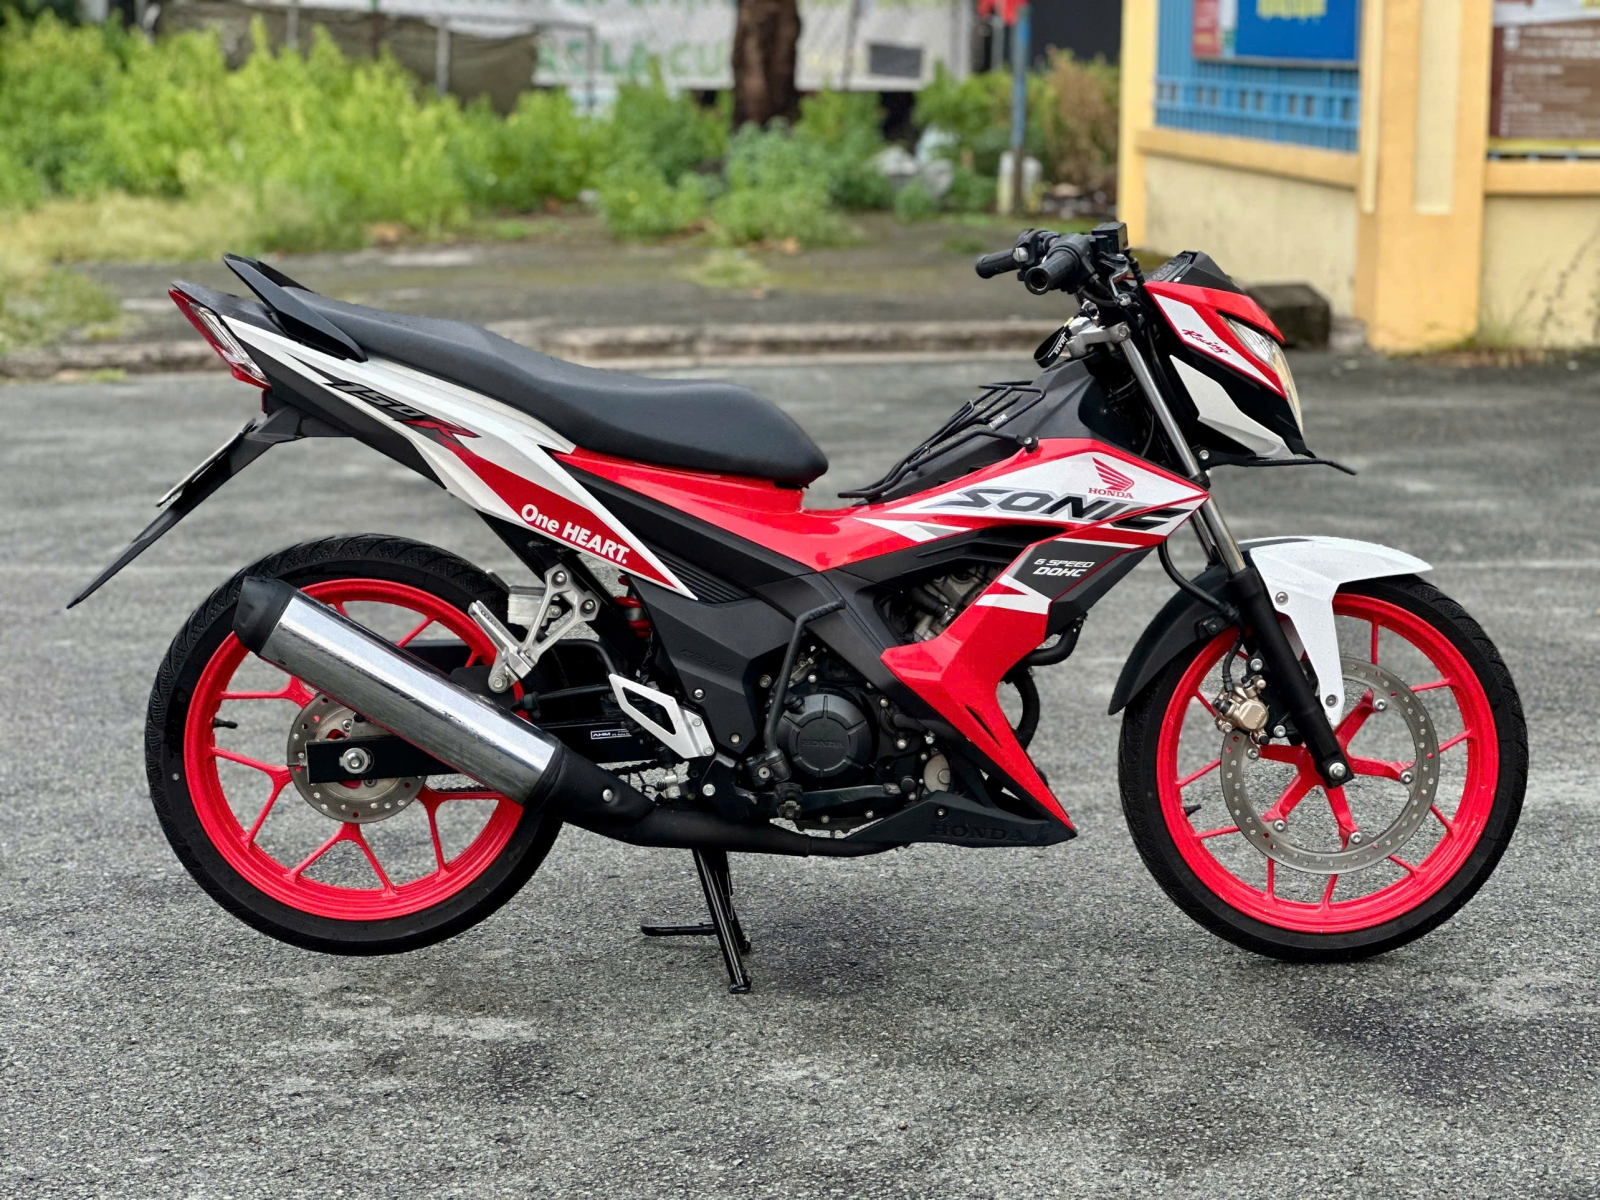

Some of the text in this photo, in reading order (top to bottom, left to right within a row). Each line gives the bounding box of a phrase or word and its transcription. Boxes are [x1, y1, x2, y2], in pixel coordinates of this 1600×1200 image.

[1088, 487, 1134, 499] HONDA
[929, 485, 1194, 531] SONIC
[521, 503, 630, 564] One HEART.
[1046, 559, 1096, 568] SPEED
[1032, 566, 1088, 577] DOHC
[802, 740, 845, 748] HONDA
[928, 823, 1028, 842] HONDA
